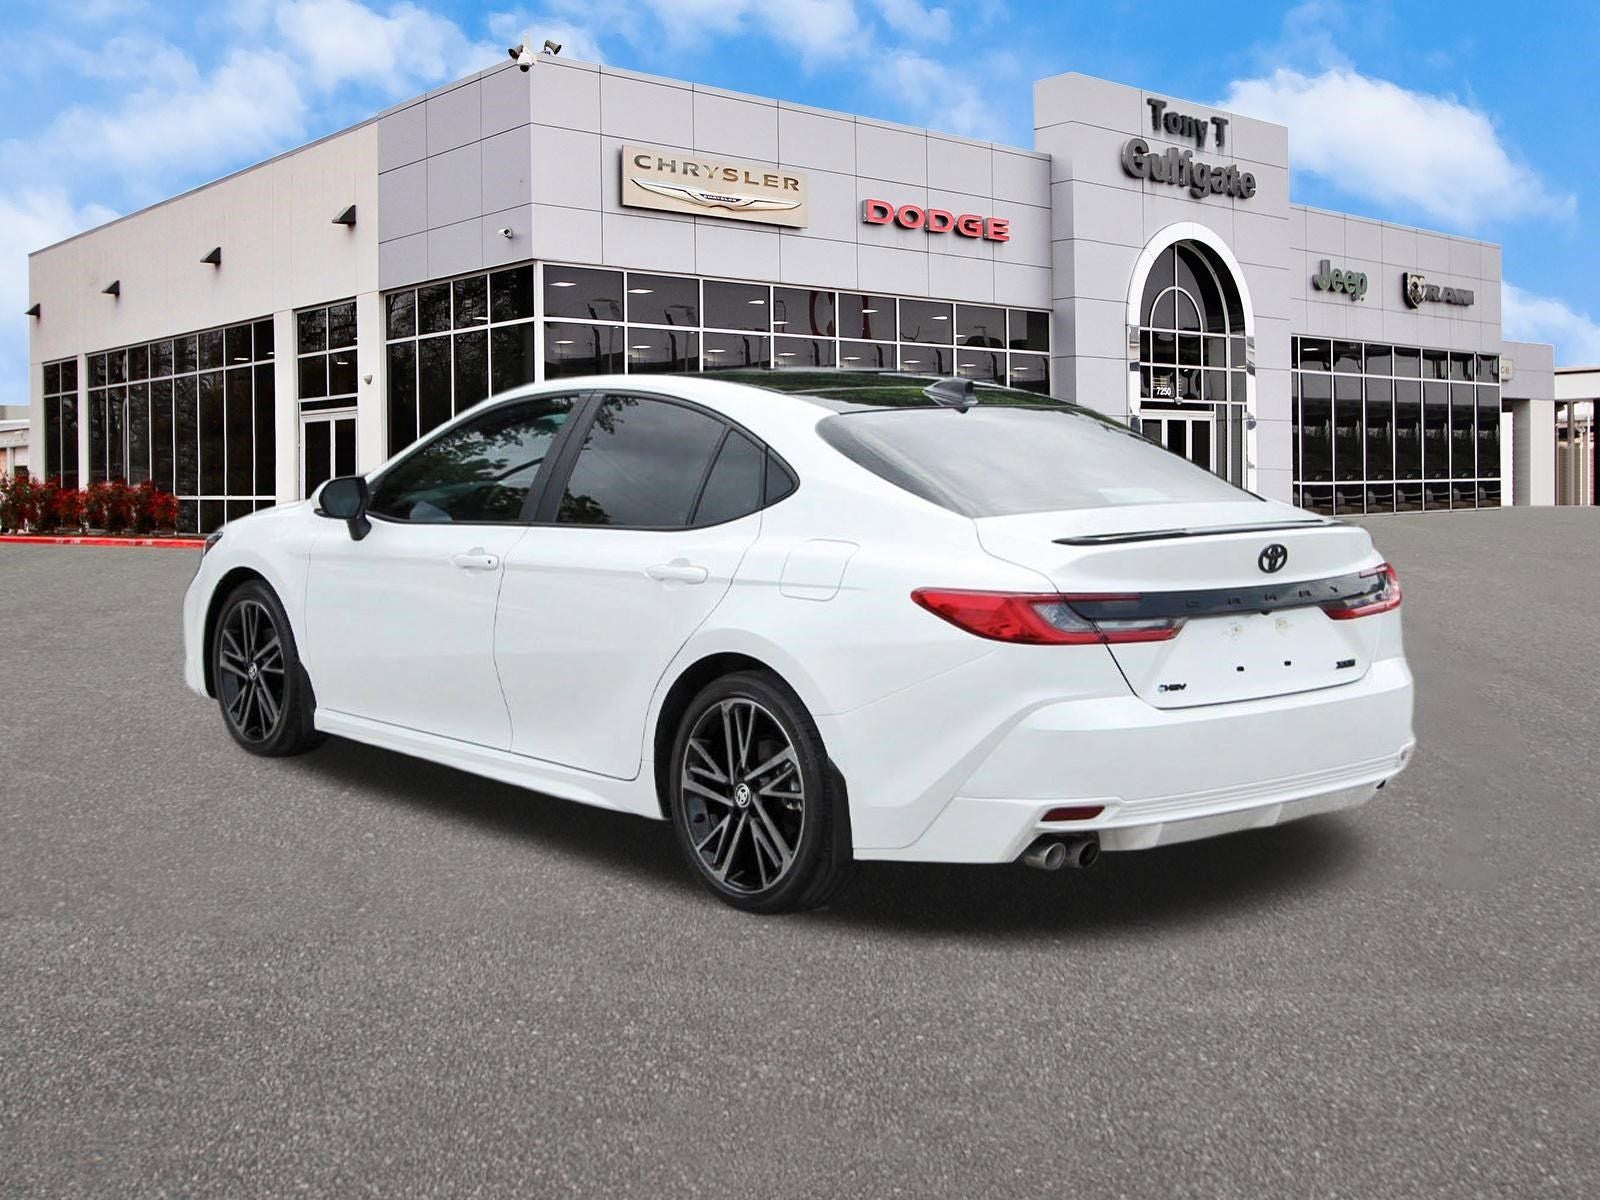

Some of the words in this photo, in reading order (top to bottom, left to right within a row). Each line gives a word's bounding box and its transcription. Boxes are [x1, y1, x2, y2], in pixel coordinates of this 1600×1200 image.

[1146, 97, 1208, 148] Tony
[1210, 116, 1229, 148] T
[633, 154, 800, 192] CHRYSLER
[1121, 138, 1257, 199] Gulfgate
[863, 199, 1011, 242] DODGE
[1312, 259, 1367, 302] Jeep
[1425, 284, 1475, 306] RAM
[1156, 386, 1171, 396] 7250
